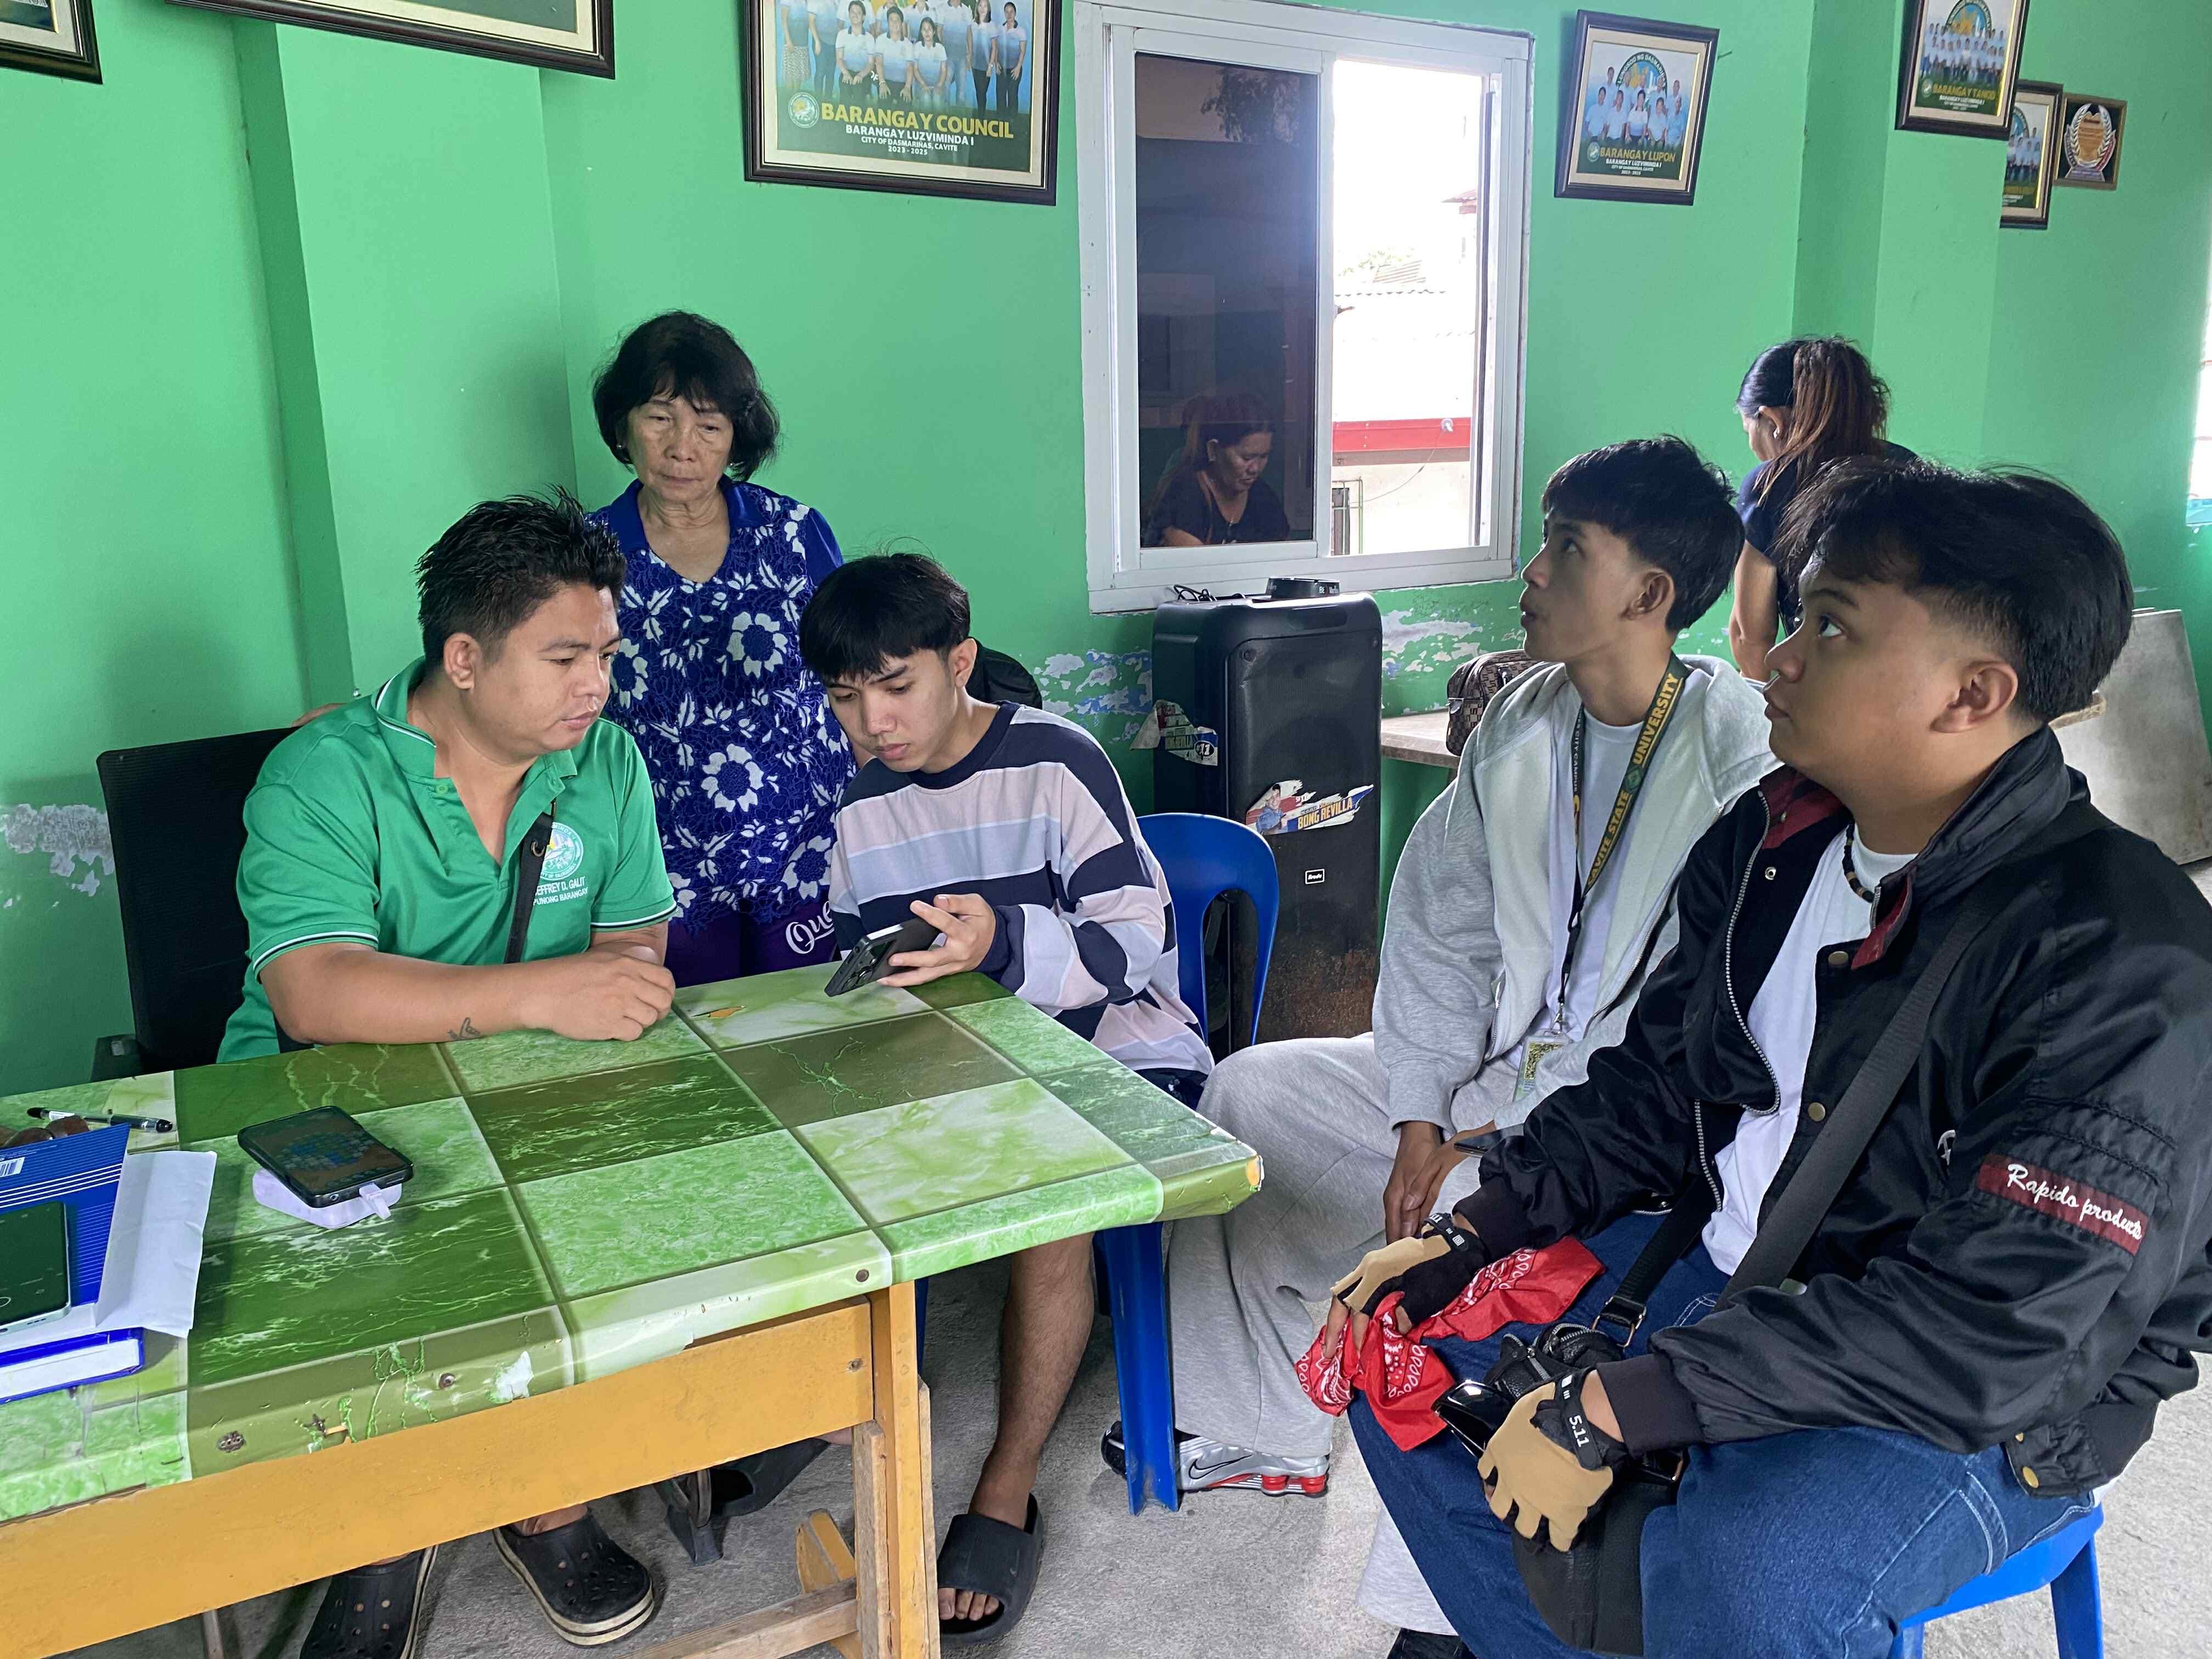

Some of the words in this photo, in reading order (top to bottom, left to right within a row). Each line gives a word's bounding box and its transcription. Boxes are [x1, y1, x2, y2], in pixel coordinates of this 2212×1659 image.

[821, 103, 933, 130] BARANGAY
[936, 115, 1014, 139] COUNCIL
[845, 124, 905, 138] BARANGAY
[907, 130, 969, 145] LUZVIMINDA
[910, 147, 928, 156] 2025
[934, 143, 958, 152] CAVITE
[1600, 147, 1647, 160] BARANGAY
[1649, 151, 1677, 162] LUPON
[1633, 673, 1679, 764] UNIVERSITY
[1298, 810, 1320, 830] BONG
[1321, 797, 1353, 821] REVILLA
[1608, 789, 1630, 835] STATE
[560, 887, 589, 901] BARANGAY
[561, 881, 568, 891] D.
[1568, 1414, 1589, 1448] 5.11
